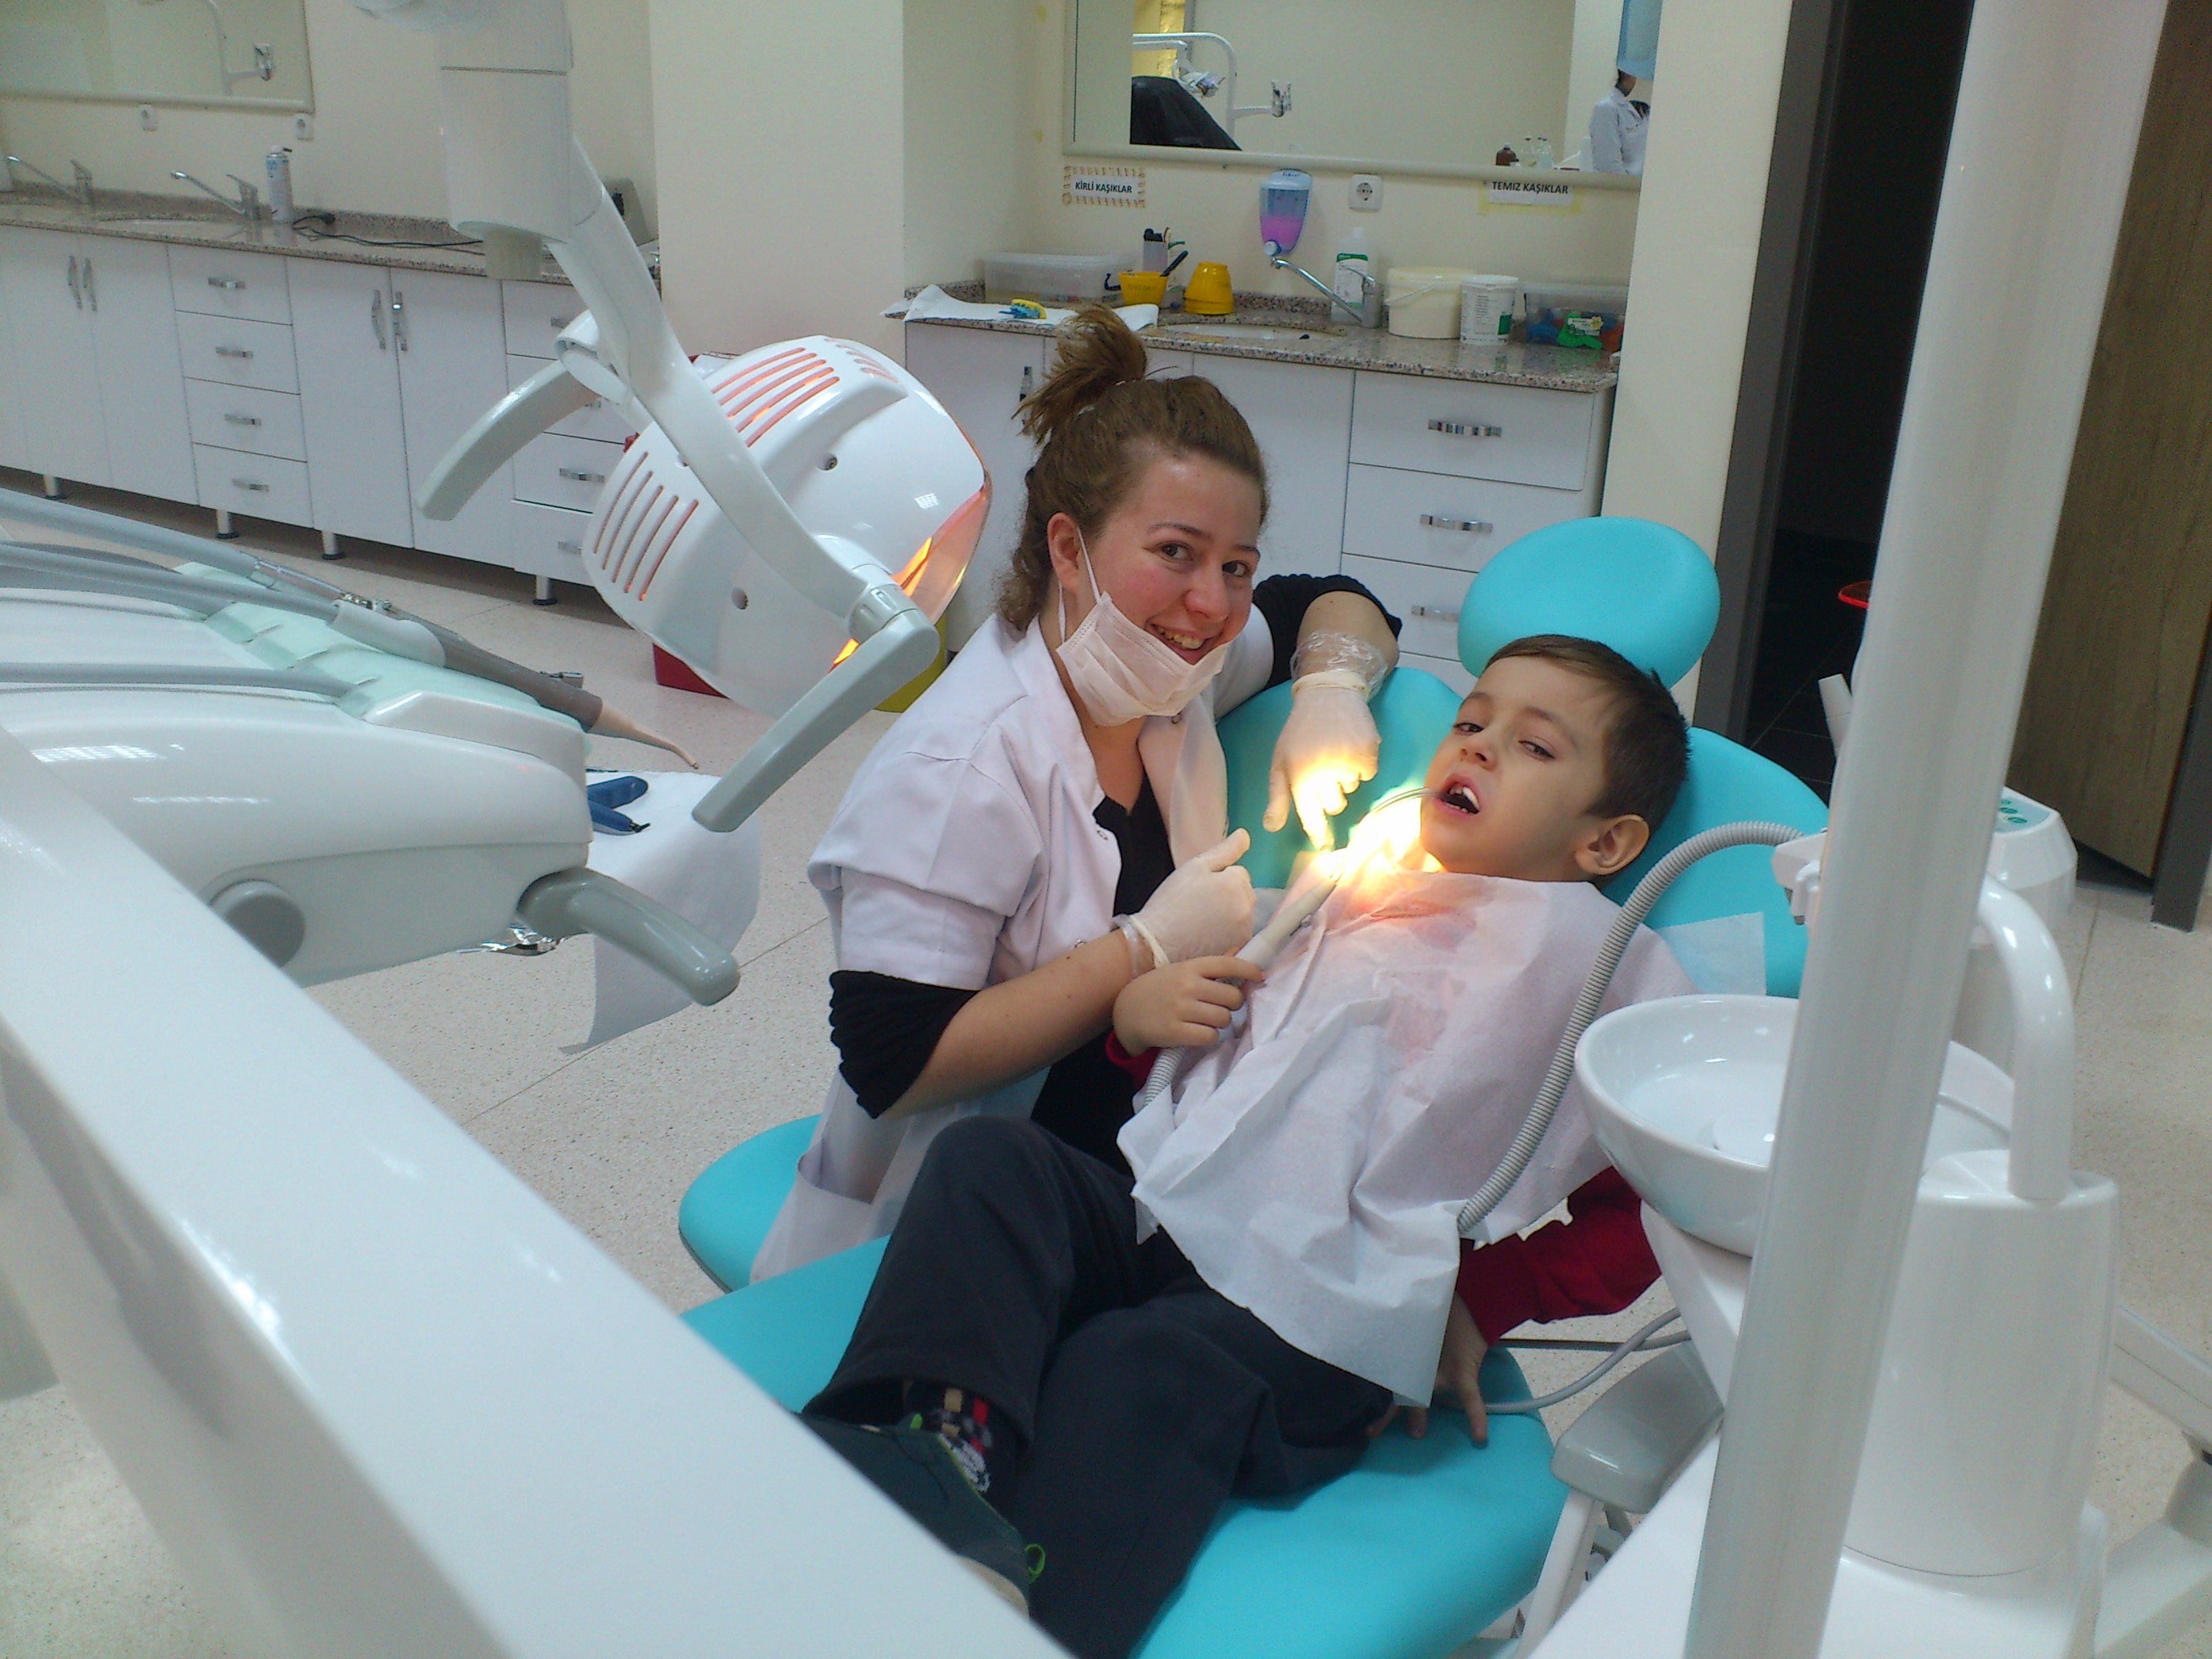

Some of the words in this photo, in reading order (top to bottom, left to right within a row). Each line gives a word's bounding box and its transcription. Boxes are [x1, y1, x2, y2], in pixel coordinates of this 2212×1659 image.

[1076, 181, 1094, 190] KİRLİ
[1096, 184, 1132, 193] KAŞIKLAR
[1523, 183, 1568, 194] KAŞIKLAR
